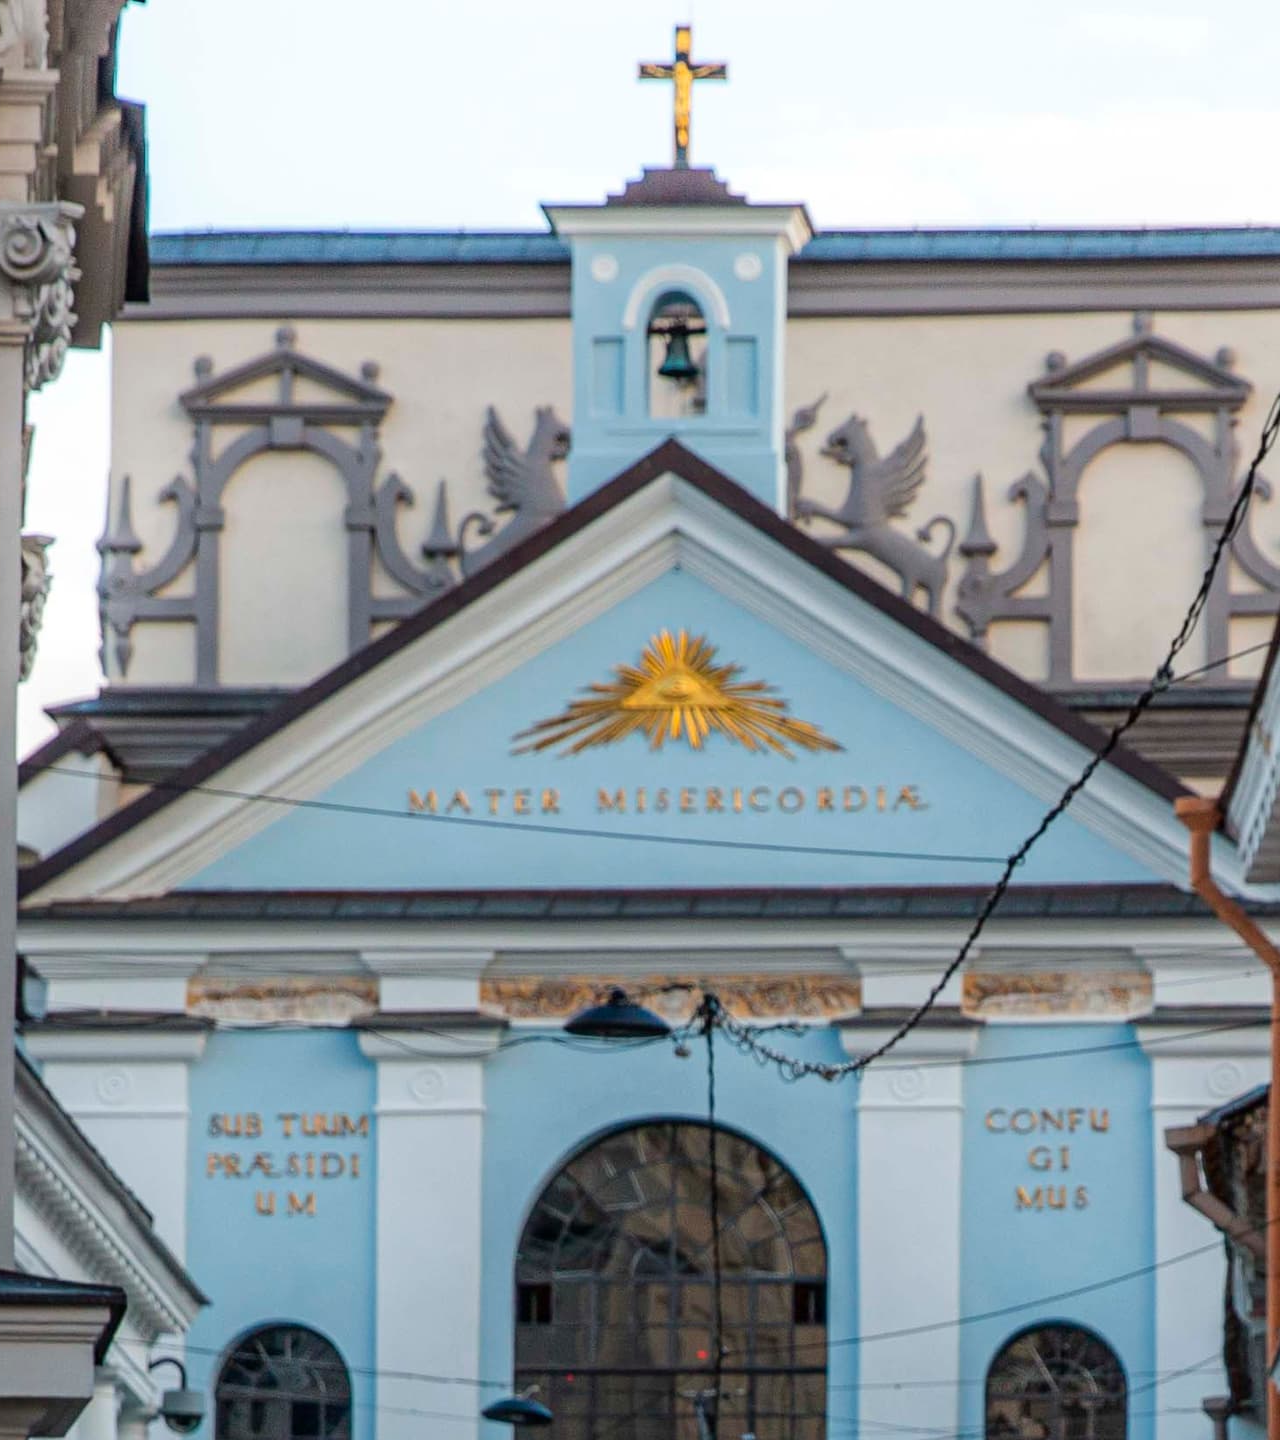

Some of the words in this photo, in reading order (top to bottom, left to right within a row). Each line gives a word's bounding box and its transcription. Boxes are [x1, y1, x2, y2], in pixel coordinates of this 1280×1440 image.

[407, 787, 562, 815] MATER
[207, 1112, 263, 1138] SUB
[277, 1112, 368, 1139] TUUM
[983, 1107, 1110, 1135] CONFU
[1027, 1144, 1070, 1172] GI
[255, 1190, 318, 1217] UM
[1014, 1184, 1089, 1212] MUS
